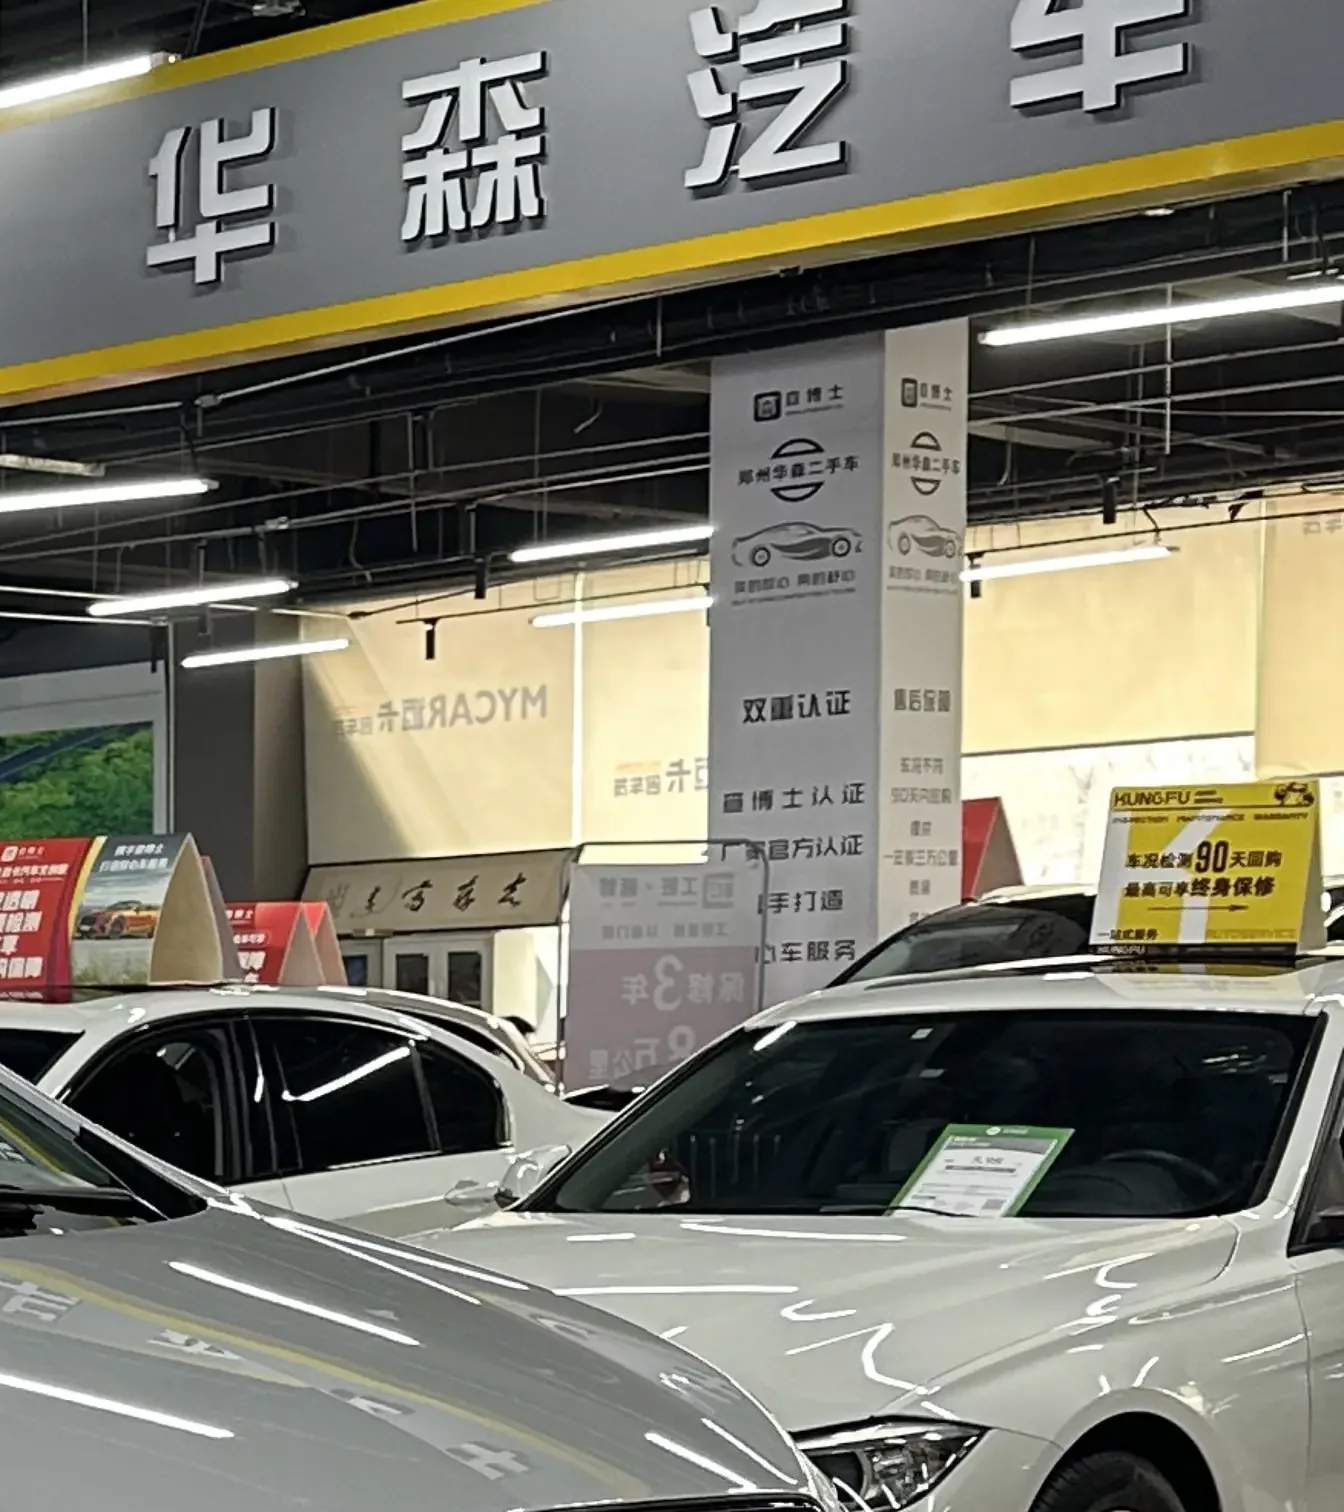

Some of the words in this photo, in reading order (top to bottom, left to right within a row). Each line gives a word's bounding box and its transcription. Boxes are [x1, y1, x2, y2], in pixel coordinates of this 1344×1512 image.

[145, 0, 1189, 286] 华森汽车
[742, 690, 851, 724] 双重认证
[723, 783, 865, 814] 查博士认证
[757, 889, 843, 915] 手打造
